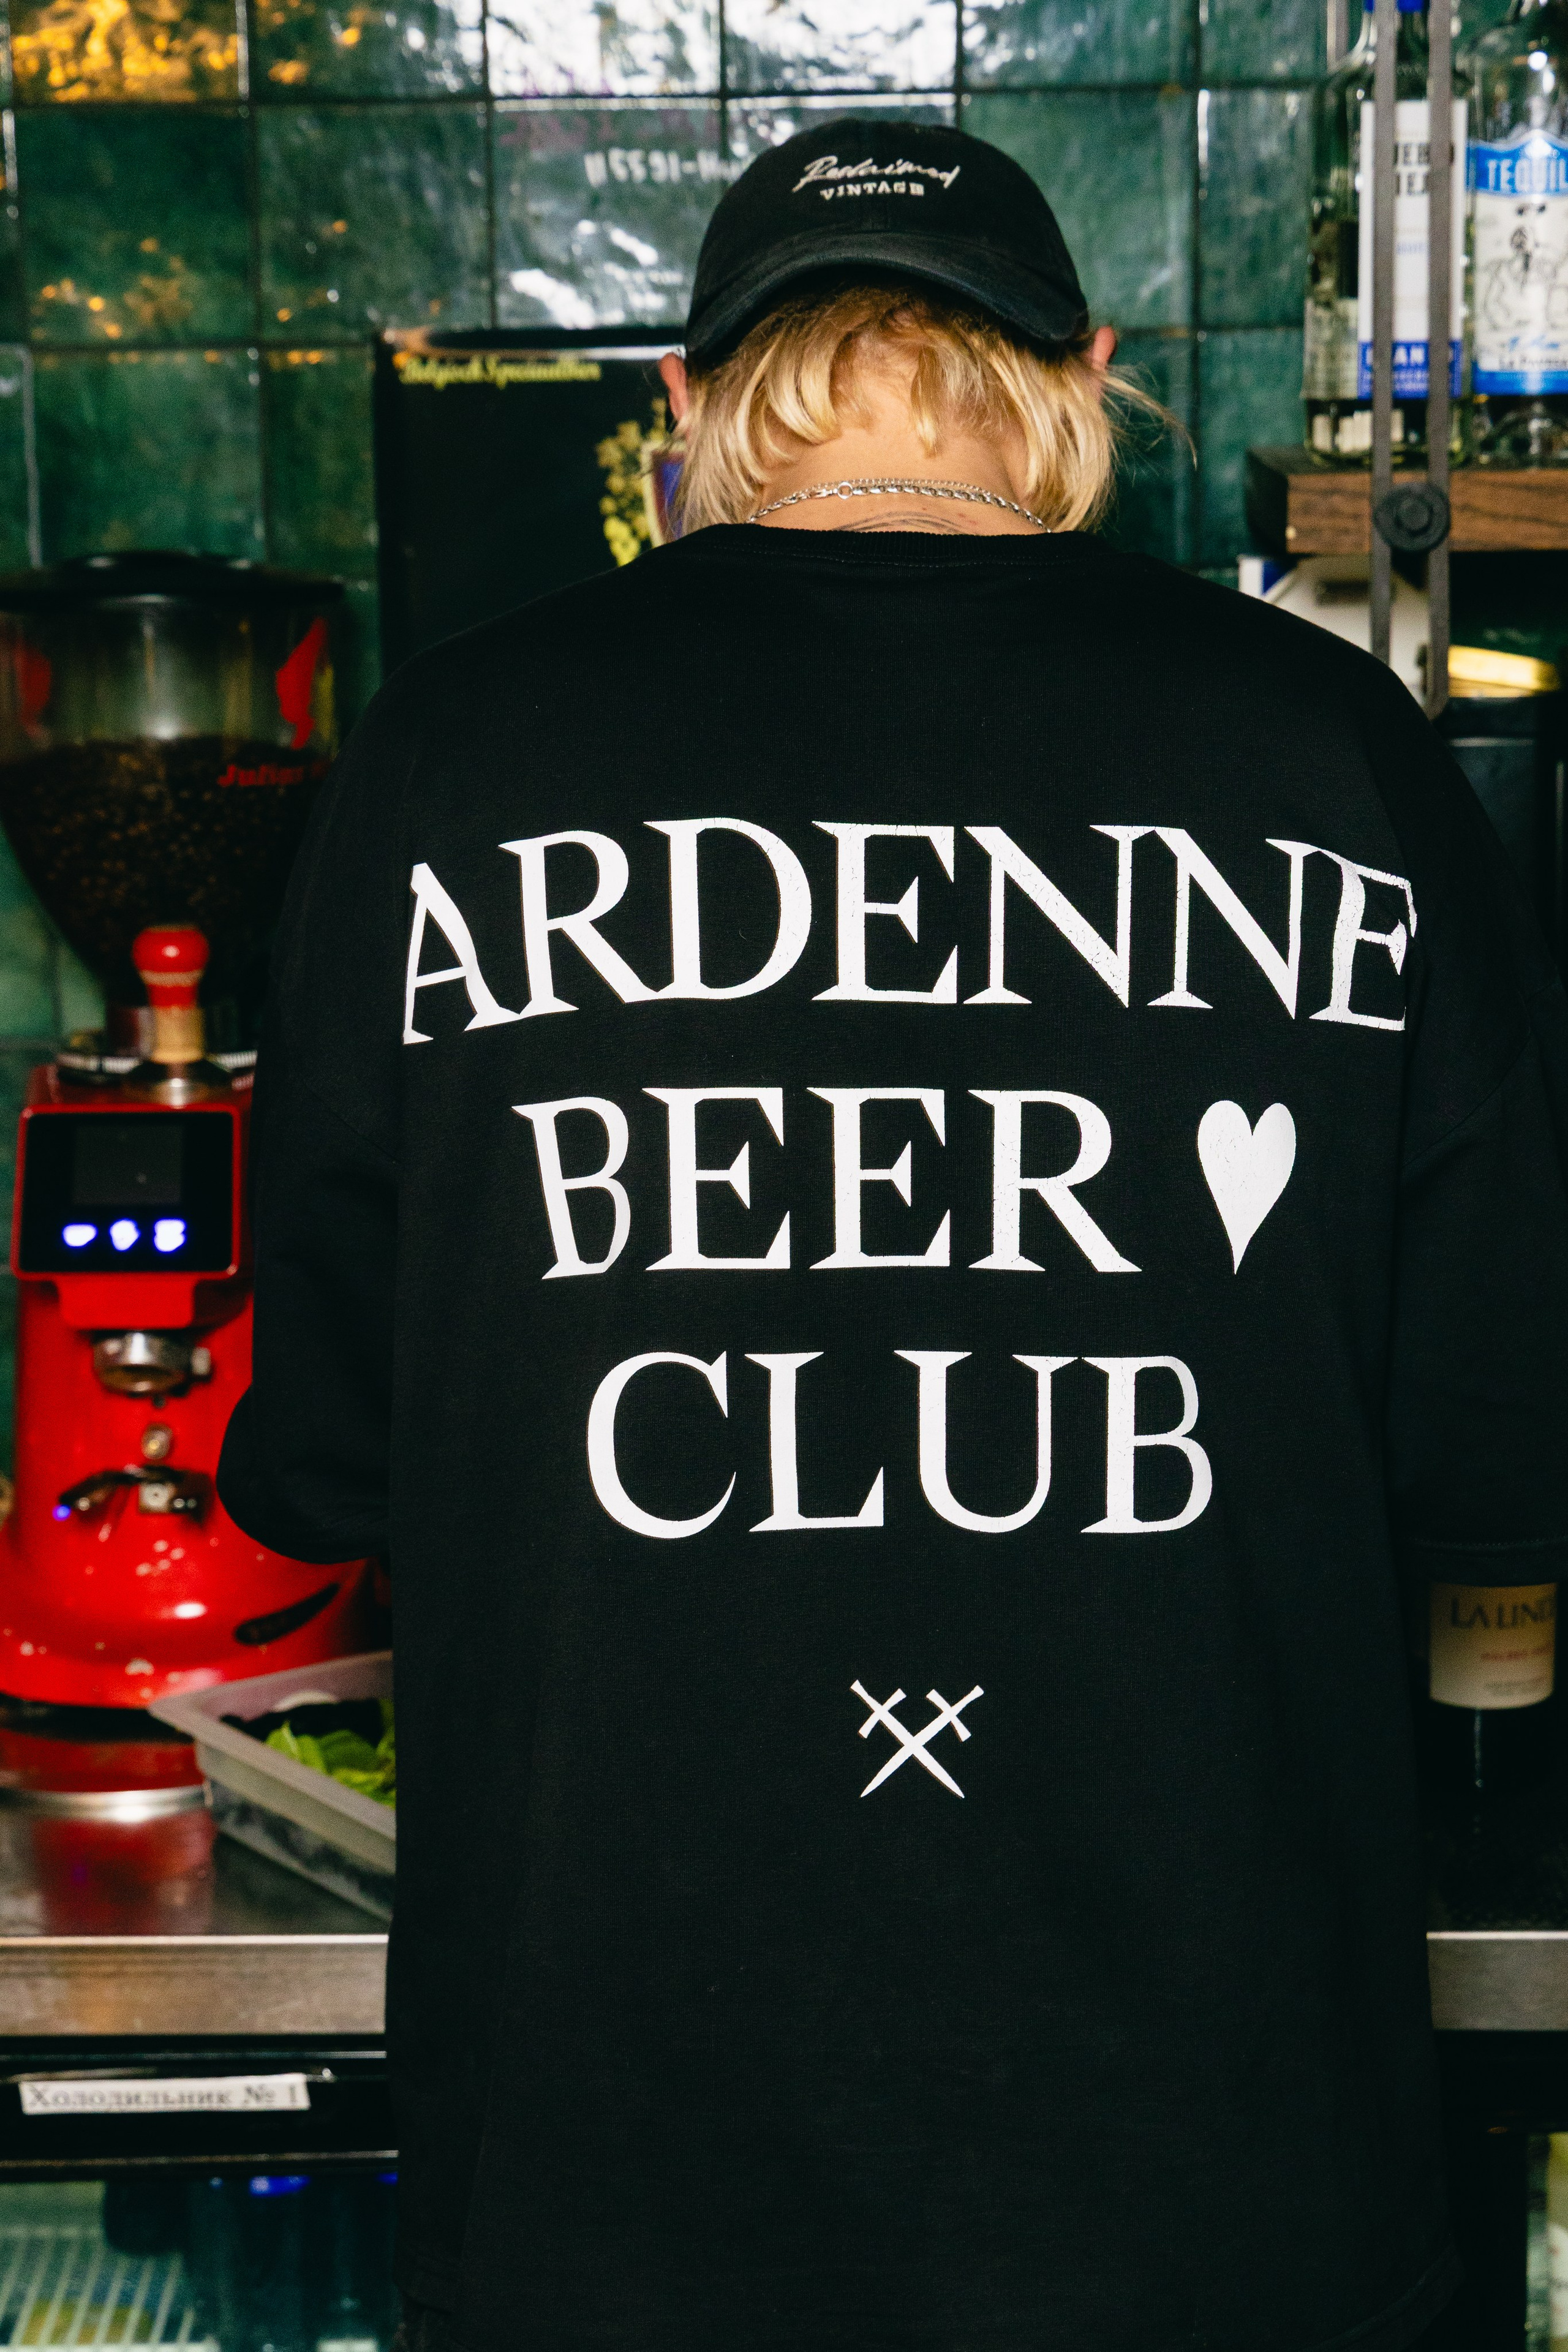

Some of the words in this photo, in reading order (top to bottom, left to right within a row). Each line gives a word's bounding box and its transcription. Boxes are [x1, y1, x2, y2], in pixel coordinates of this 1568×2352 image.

[820, 180, 924, 200] VINTAGE
[402, 817, 1417, 1044] ARDENNE
[511, 1087, 1142, 1280] BEER
[587, 1349, 1213, 1539] CLUB
[28, 2084, 233, 2107] Холодильник
